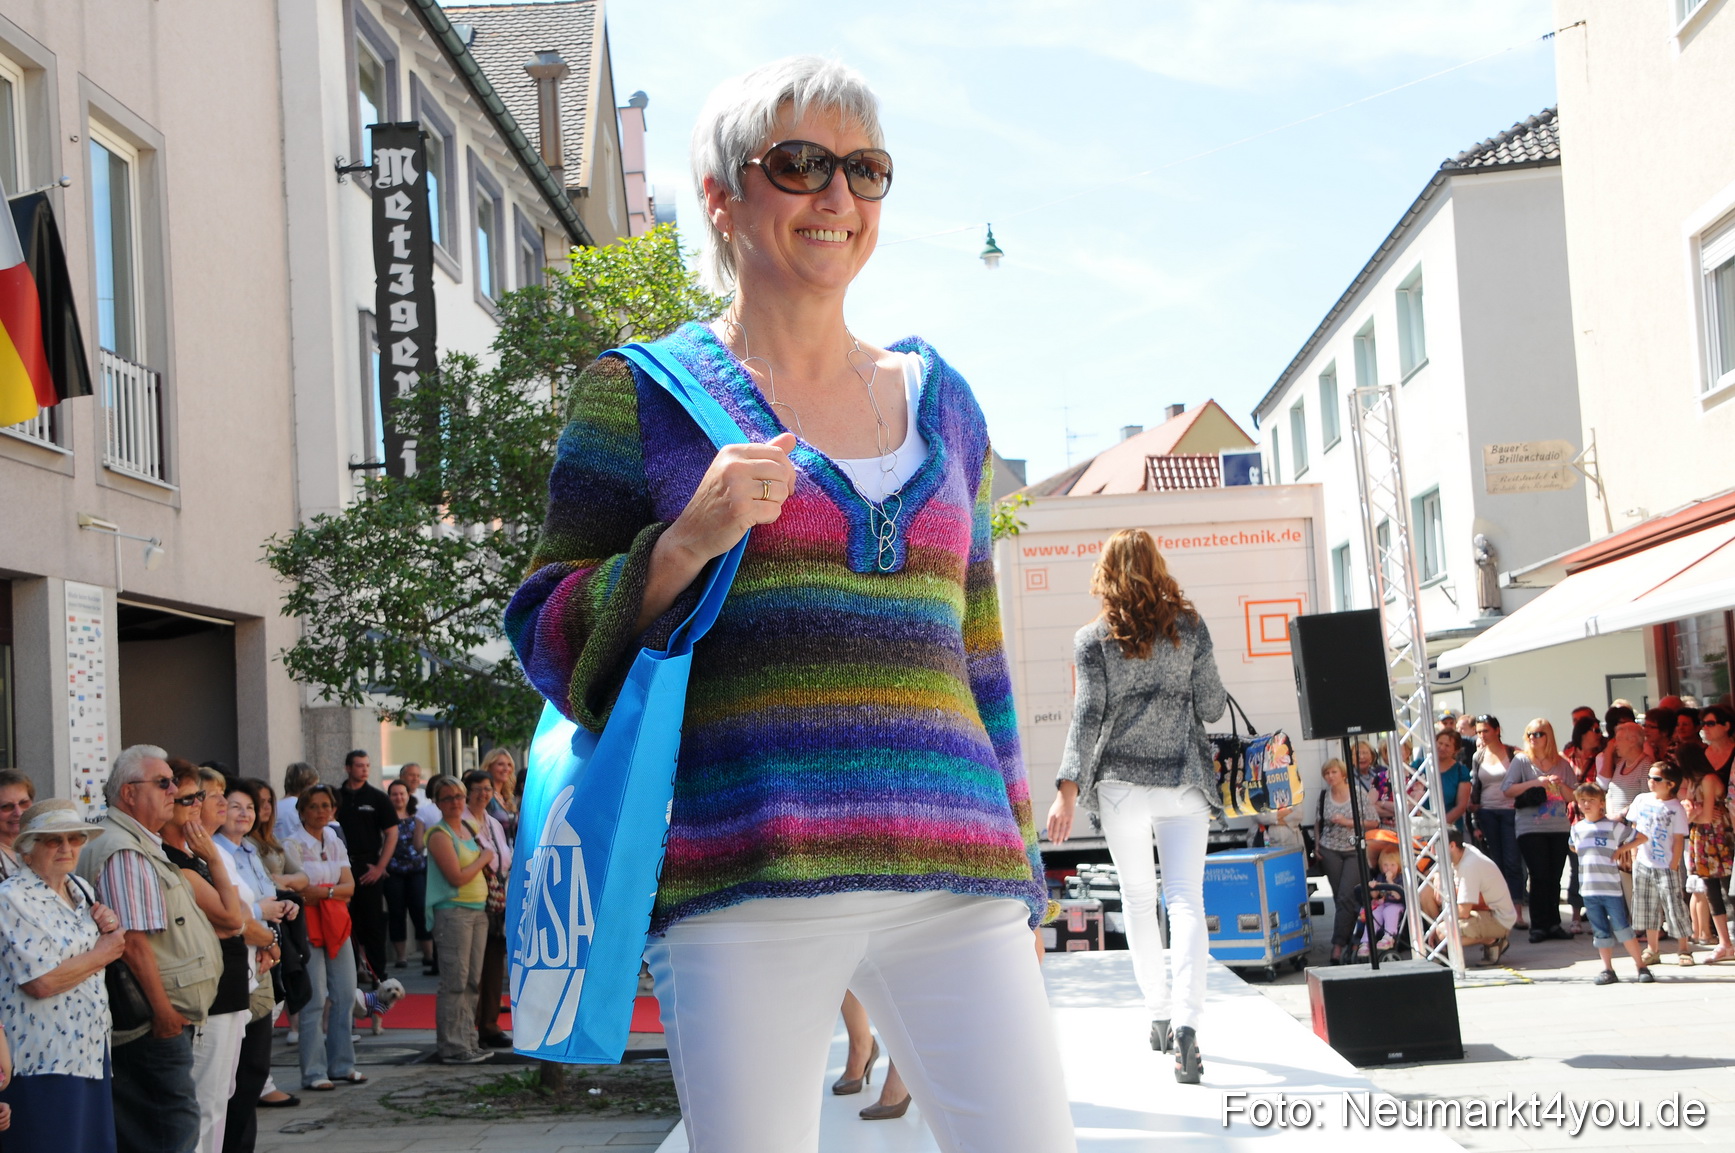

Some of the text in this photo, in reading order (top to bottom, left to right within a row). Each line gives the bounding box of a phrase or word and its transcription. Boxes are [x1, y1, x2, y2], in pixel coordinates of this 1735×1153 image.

[1498, 451, 1560, 464] Brillenstudio
[1034, 710, 1062, 724] petri
[1594, 836, 1608, 847] 53
